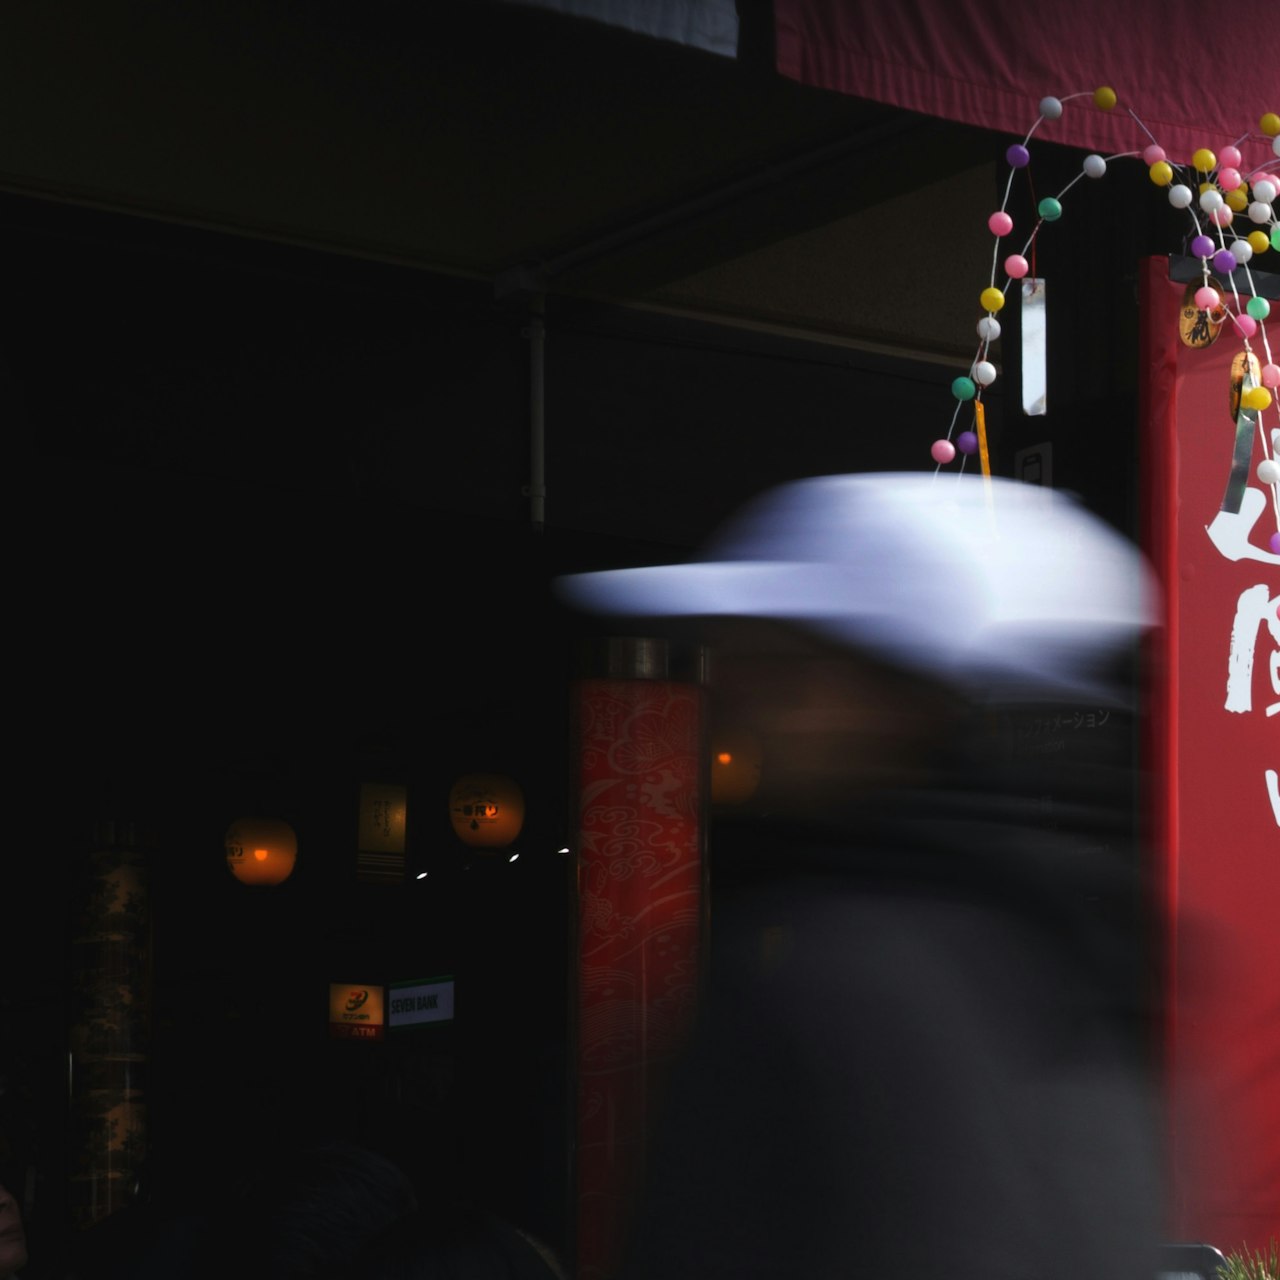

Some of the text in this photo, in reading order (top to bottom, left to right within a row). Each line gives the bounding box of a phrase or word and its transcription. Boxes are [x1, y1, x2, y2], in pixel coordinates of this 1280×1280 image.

[391, 994, 438, 1015] SEVEN BANK
[351, 1027, 376, 1037] ATM
